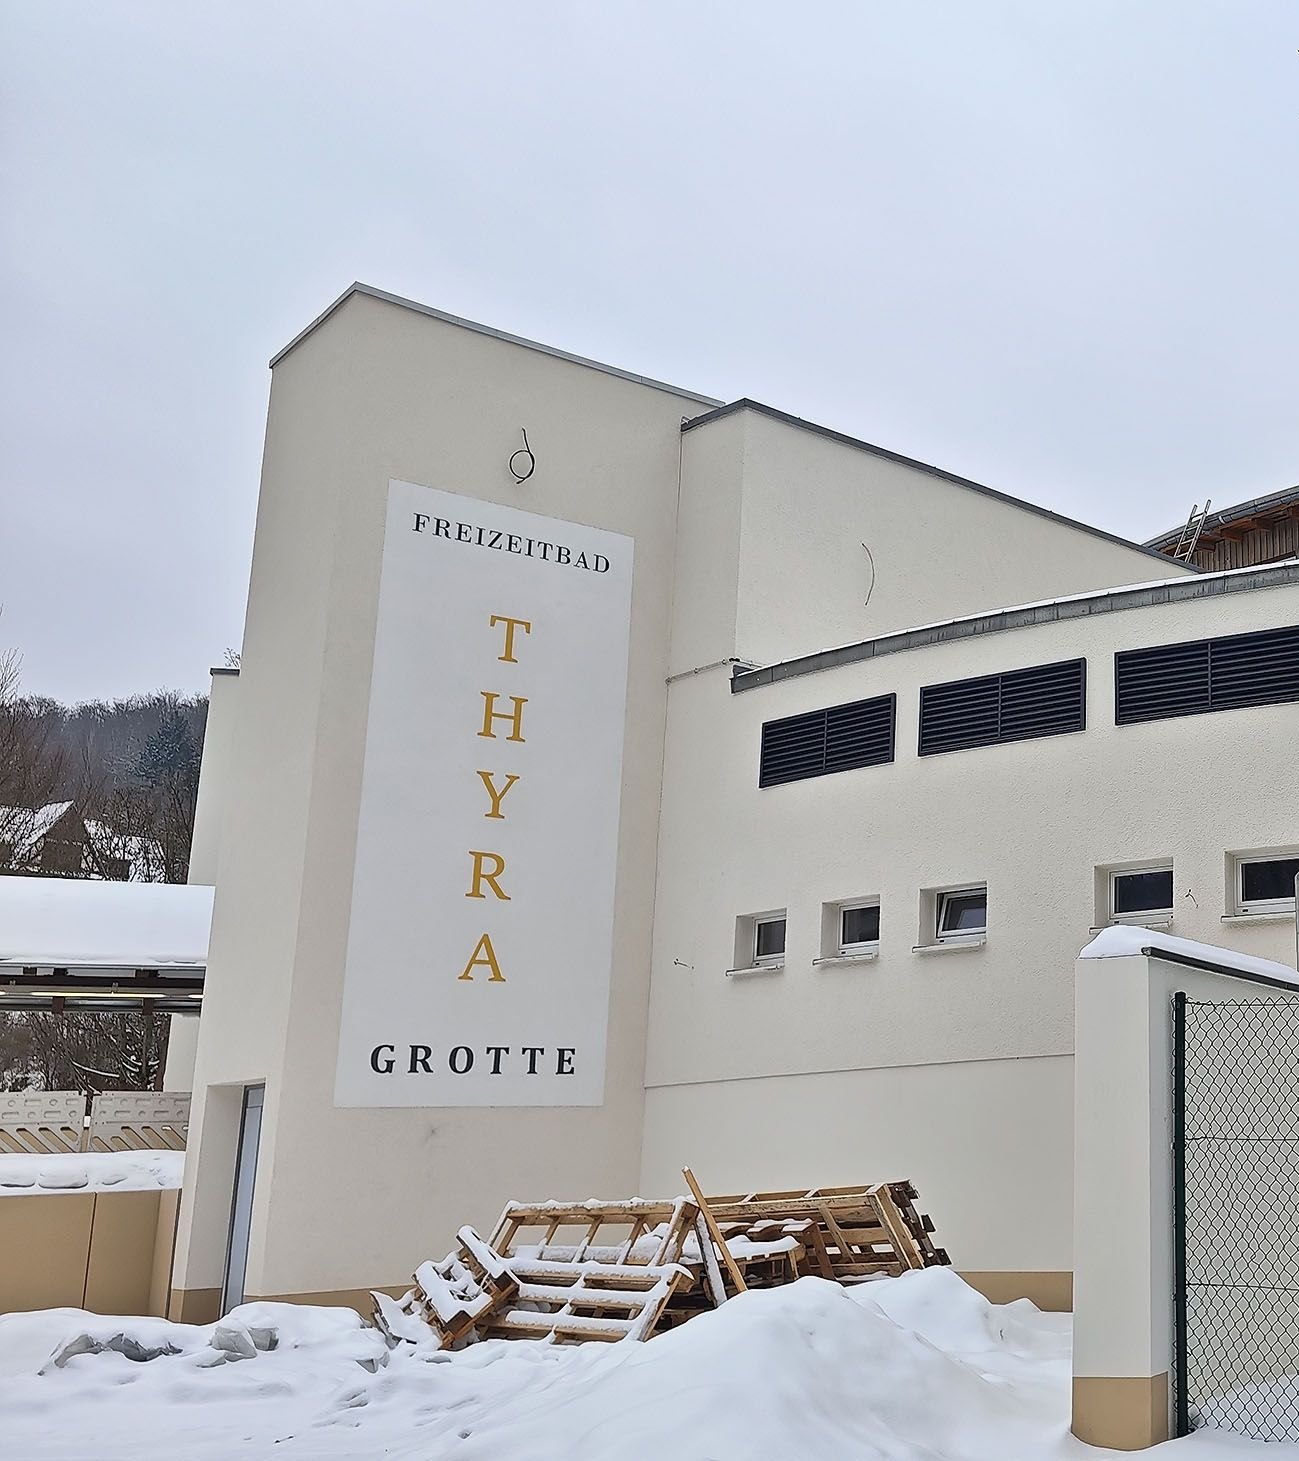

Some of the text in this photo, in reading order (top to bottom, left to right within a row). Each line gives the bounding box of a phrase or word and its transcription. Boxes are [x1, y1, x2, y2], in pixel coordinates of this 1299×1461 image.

[411, 512, 611, 573] FREIZEITBAD
[458, 615, 531, 982] THYRA
[370, 1044, 576, 1076] GROTTE
